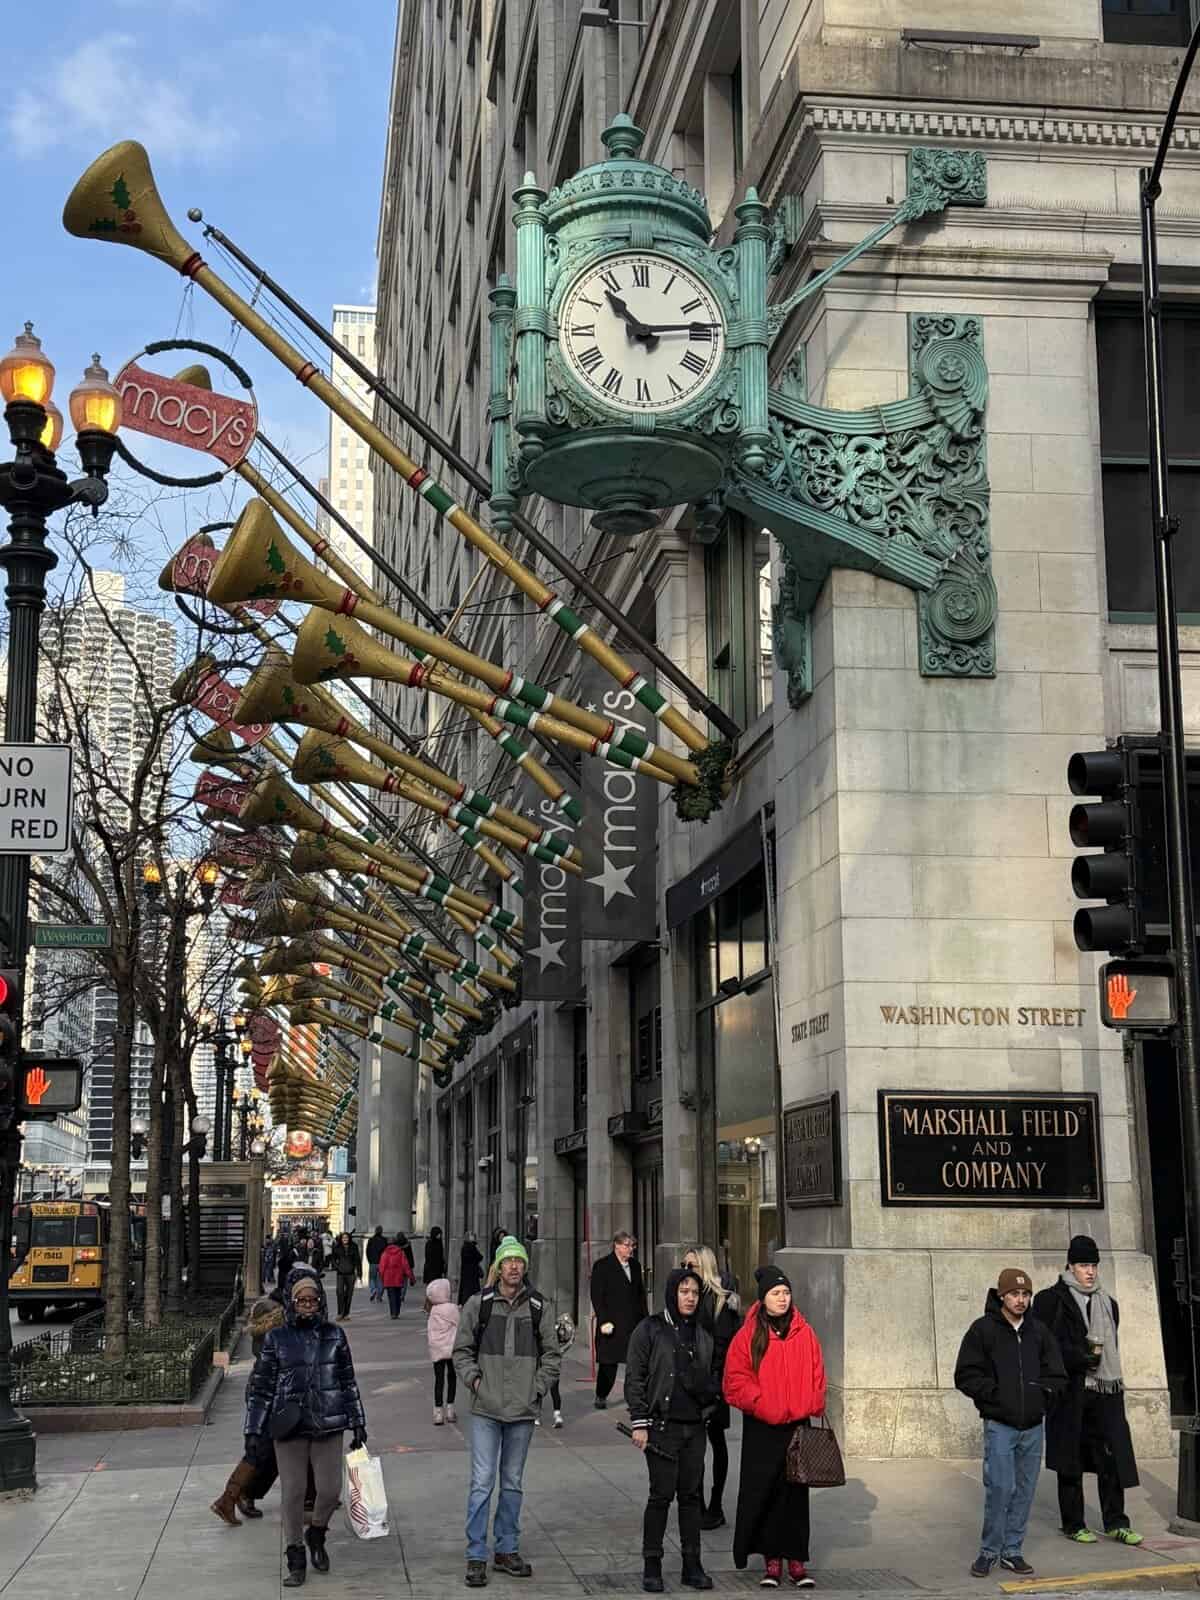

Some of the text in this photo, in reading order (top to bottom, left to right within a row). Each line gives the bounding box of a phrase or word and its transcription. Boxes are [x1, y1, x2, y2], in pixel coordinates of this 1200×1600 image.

[119, 379, 250, 449] macy's
[584, 689, 646, 851] may's
[0, 787, 46, 808] URN
[11, 819, 58, 839] RED
[880, 1006, 1087, 1027] WASHINGTON STREET
[903, 1108, 1080, 1137] MARSHALL FIELD
[972, 1141, 1012, 1156] AND
[942, 1161, 1047, 1189] COMPANY
